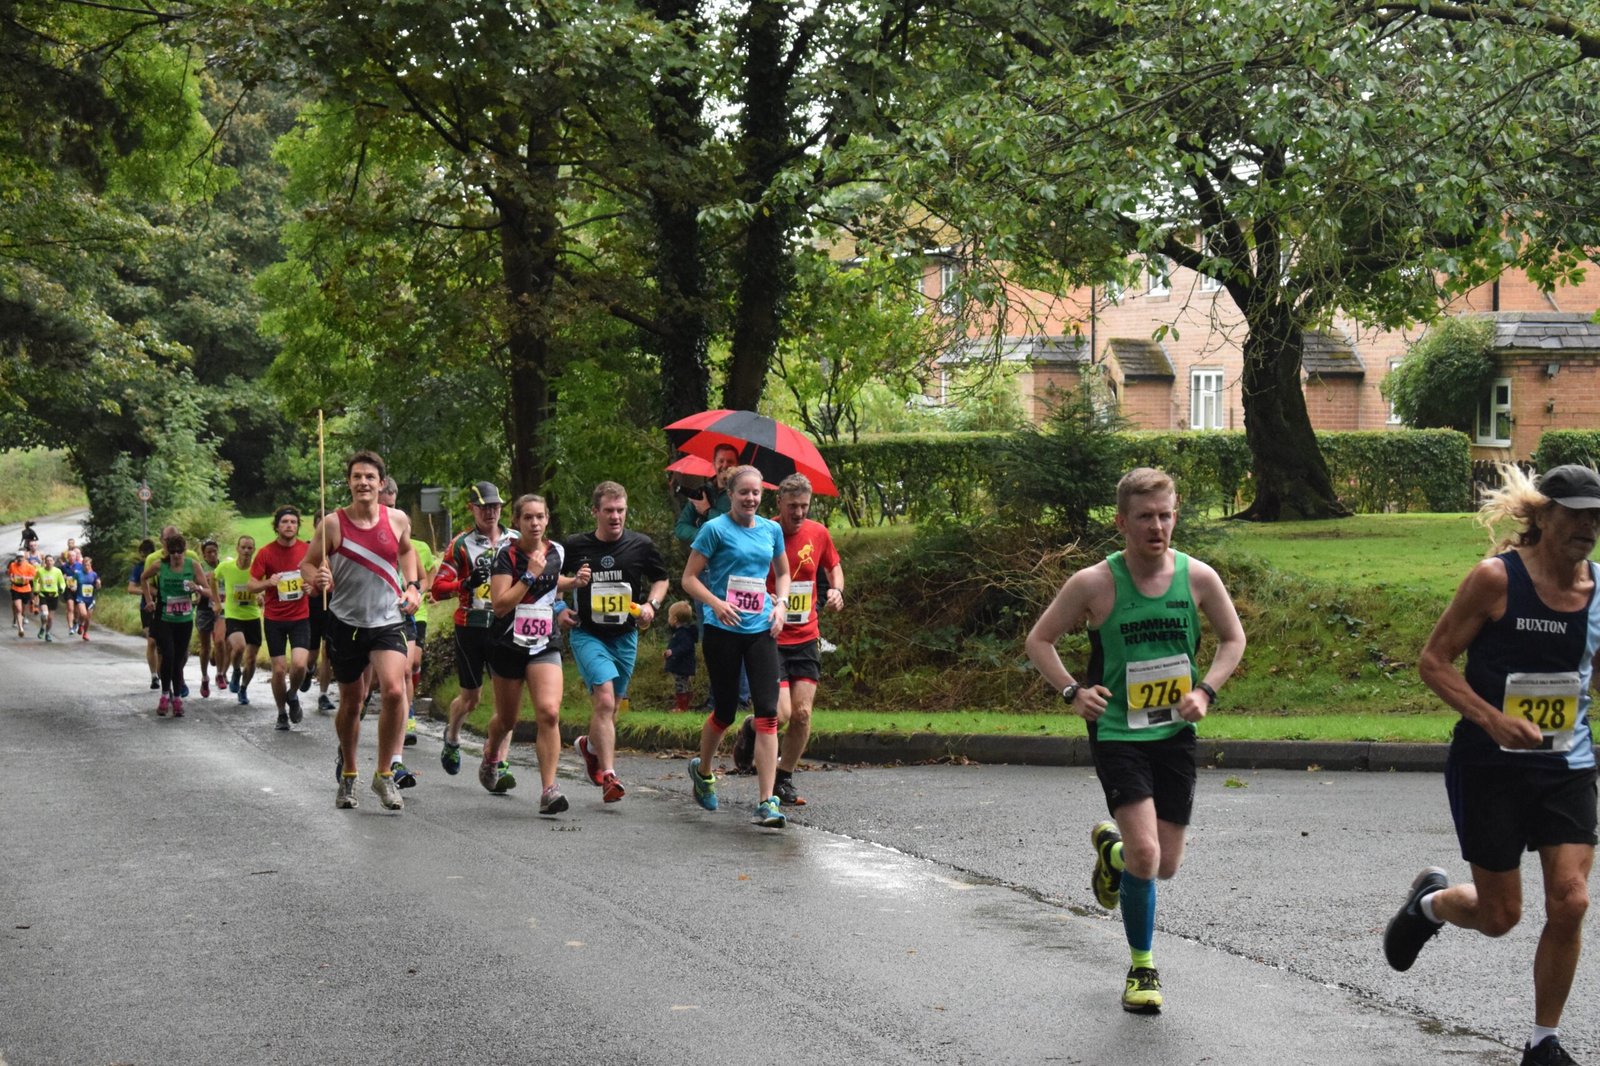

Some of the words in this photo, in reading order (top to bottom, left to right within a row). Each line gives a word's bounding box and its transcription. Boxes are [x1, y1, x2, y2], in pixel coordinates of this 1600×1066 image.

[592, 570, 622, 581] MARTIN
[287, 580, 298, 591] 13
[602, 596, 622, 612] 151
[735, 591, 759, 610] 506
[522, 618, 547, 636] 658
[1120, 618, 1188, 635] BRAMHALL
[1516, 617, 1568, 634] BUXTON
[1125, 630, 1187, 646] RUNNERS
[1140, 680, 1181, 708] 276
[1519, 698, 1565, 729] 328
